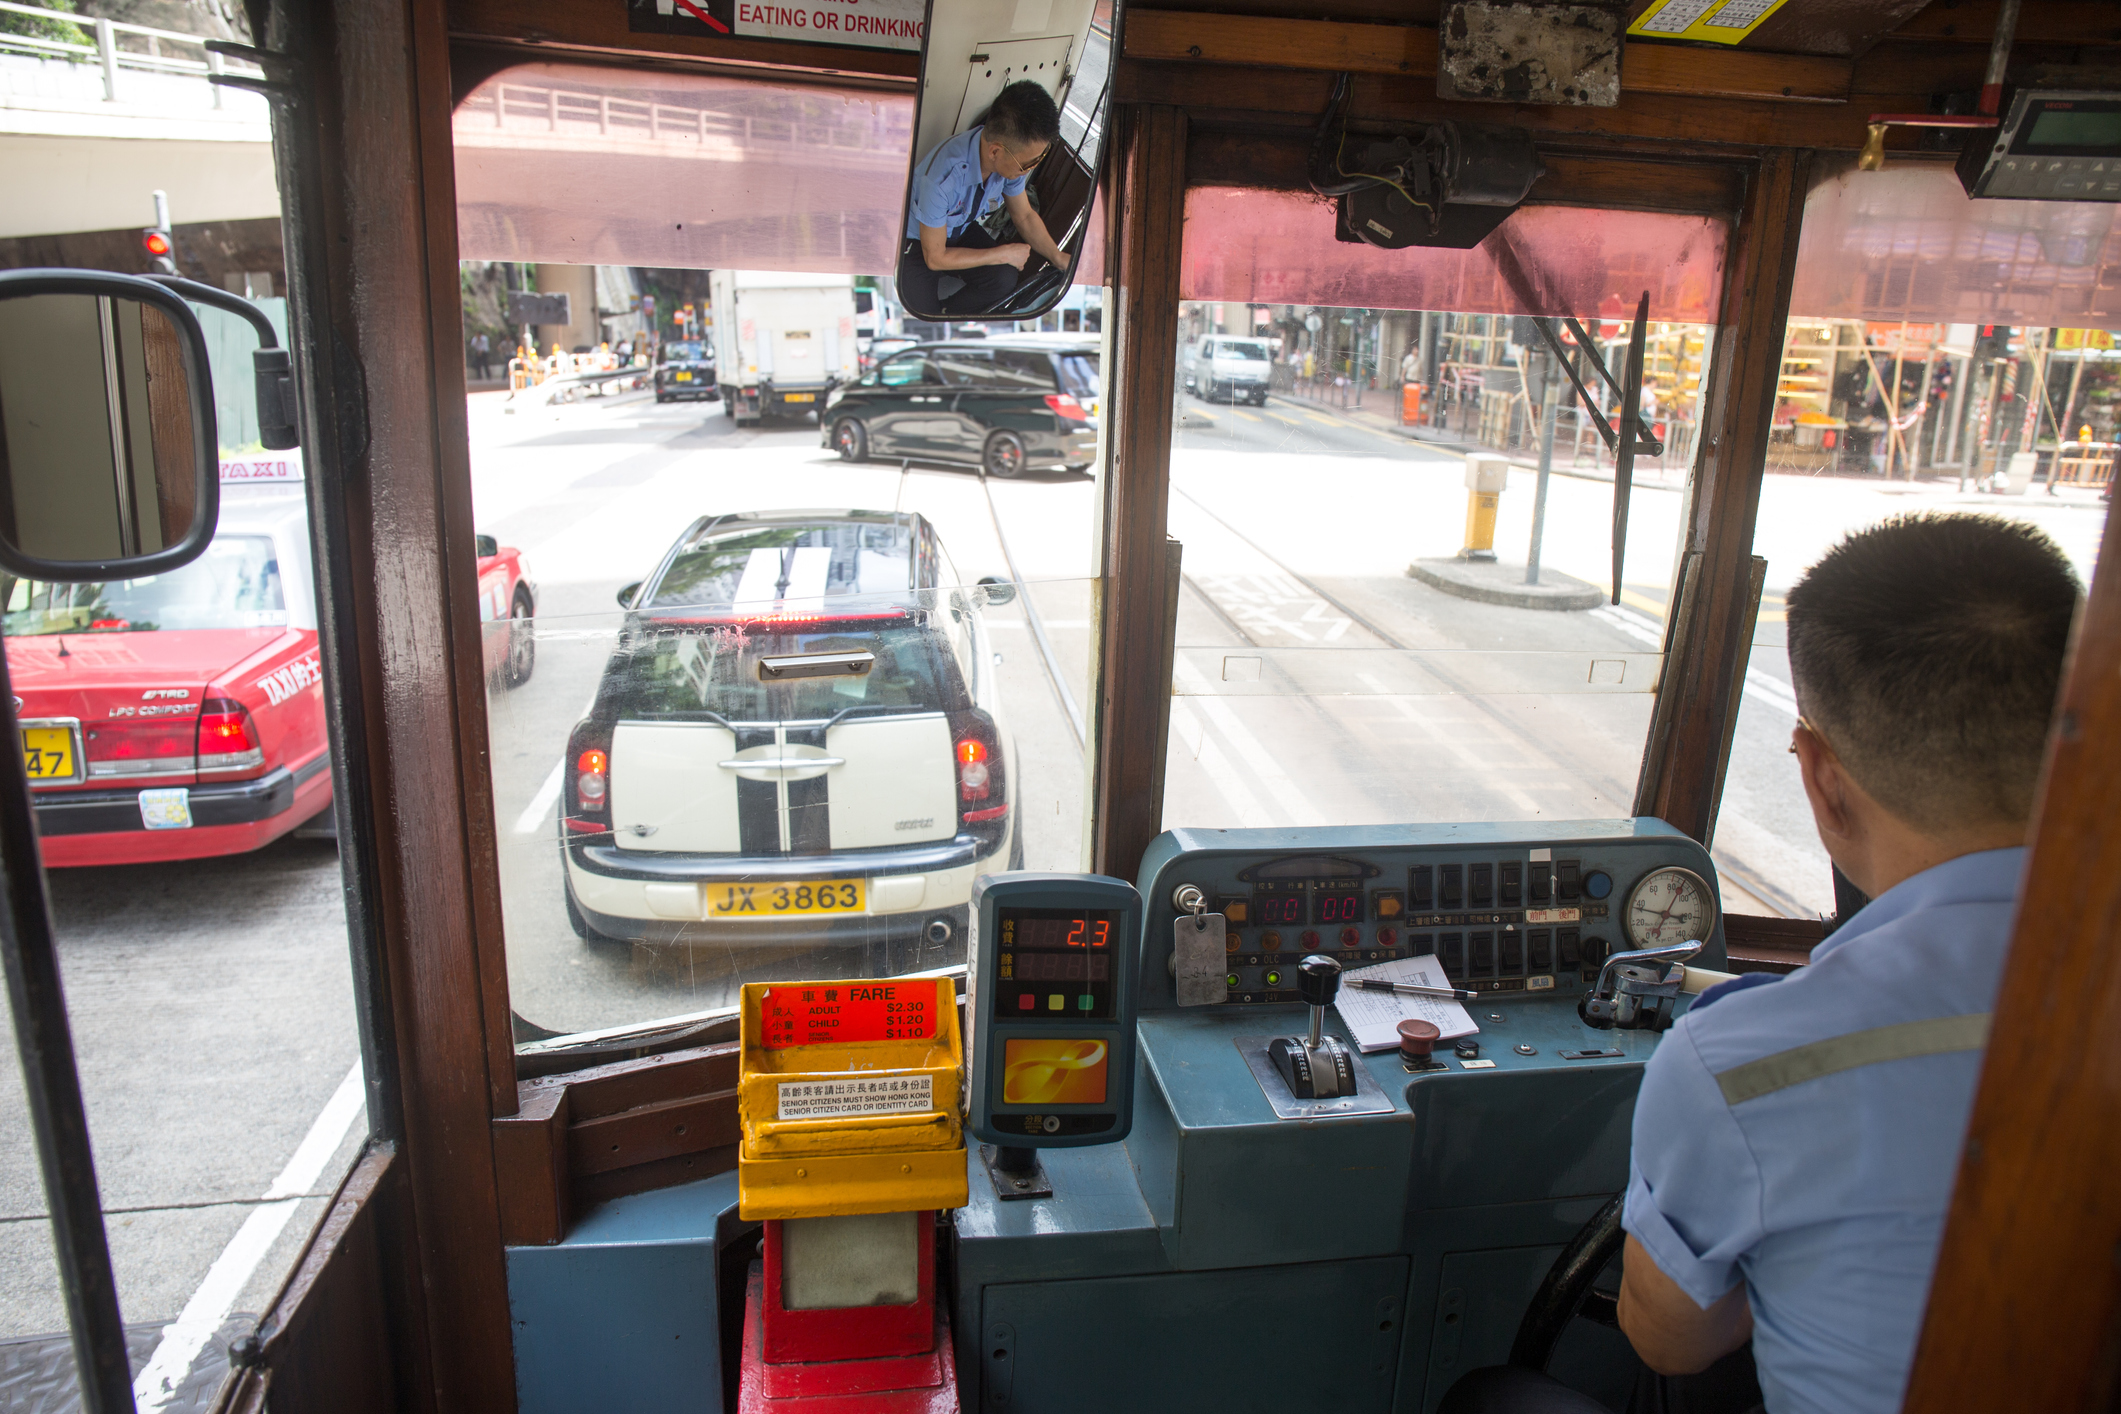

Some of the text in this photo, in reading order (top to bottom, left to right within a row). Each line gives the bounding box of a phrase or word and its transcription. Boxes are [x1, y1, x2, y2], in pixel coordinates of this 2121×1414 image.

[739, 4, 807, 28] EATING
[812, 11, 839, 30] OR
[1649, 883, 1676, 893] 60 80
[717, 884, 858, 912] JX 3863
[1323, 897, 1356, 920] 00
[1529, 908, 1577, 921] 前門 後門
[1636, 918, 1645, 926] 20
[1002, 919, 1014, 944] 收費
[1066, 919, 1110, 947] 2.3
[1675, 930, 1686, 938] 140
[1000, 953, 1013, 977] 餘額
[1263, 954, 1280, 964] OLC
[850, 987, 896, 1001] FARE
[772, 1002, 924, 1017] 成人 ADULT $2.30
[772, 1015, 924, 1031] 小童 CHILD $1.20
[772, 1034, 794, 1044] 長者
[886, 1028, 923, 1039] $1.10
[781, 1092, 931, 1107] SENIOR CITIZENS MUST SHOW HONG KONG
[784, 1107, 811, 1115] SENIOR
[812, 1106, 840, 1114] CITIZEN
[841, 1104, 862, 1112] CARD
[875, 1101, 907, 1109] IDENTITY
[1025, 1114, 1043, 1123] 分段
